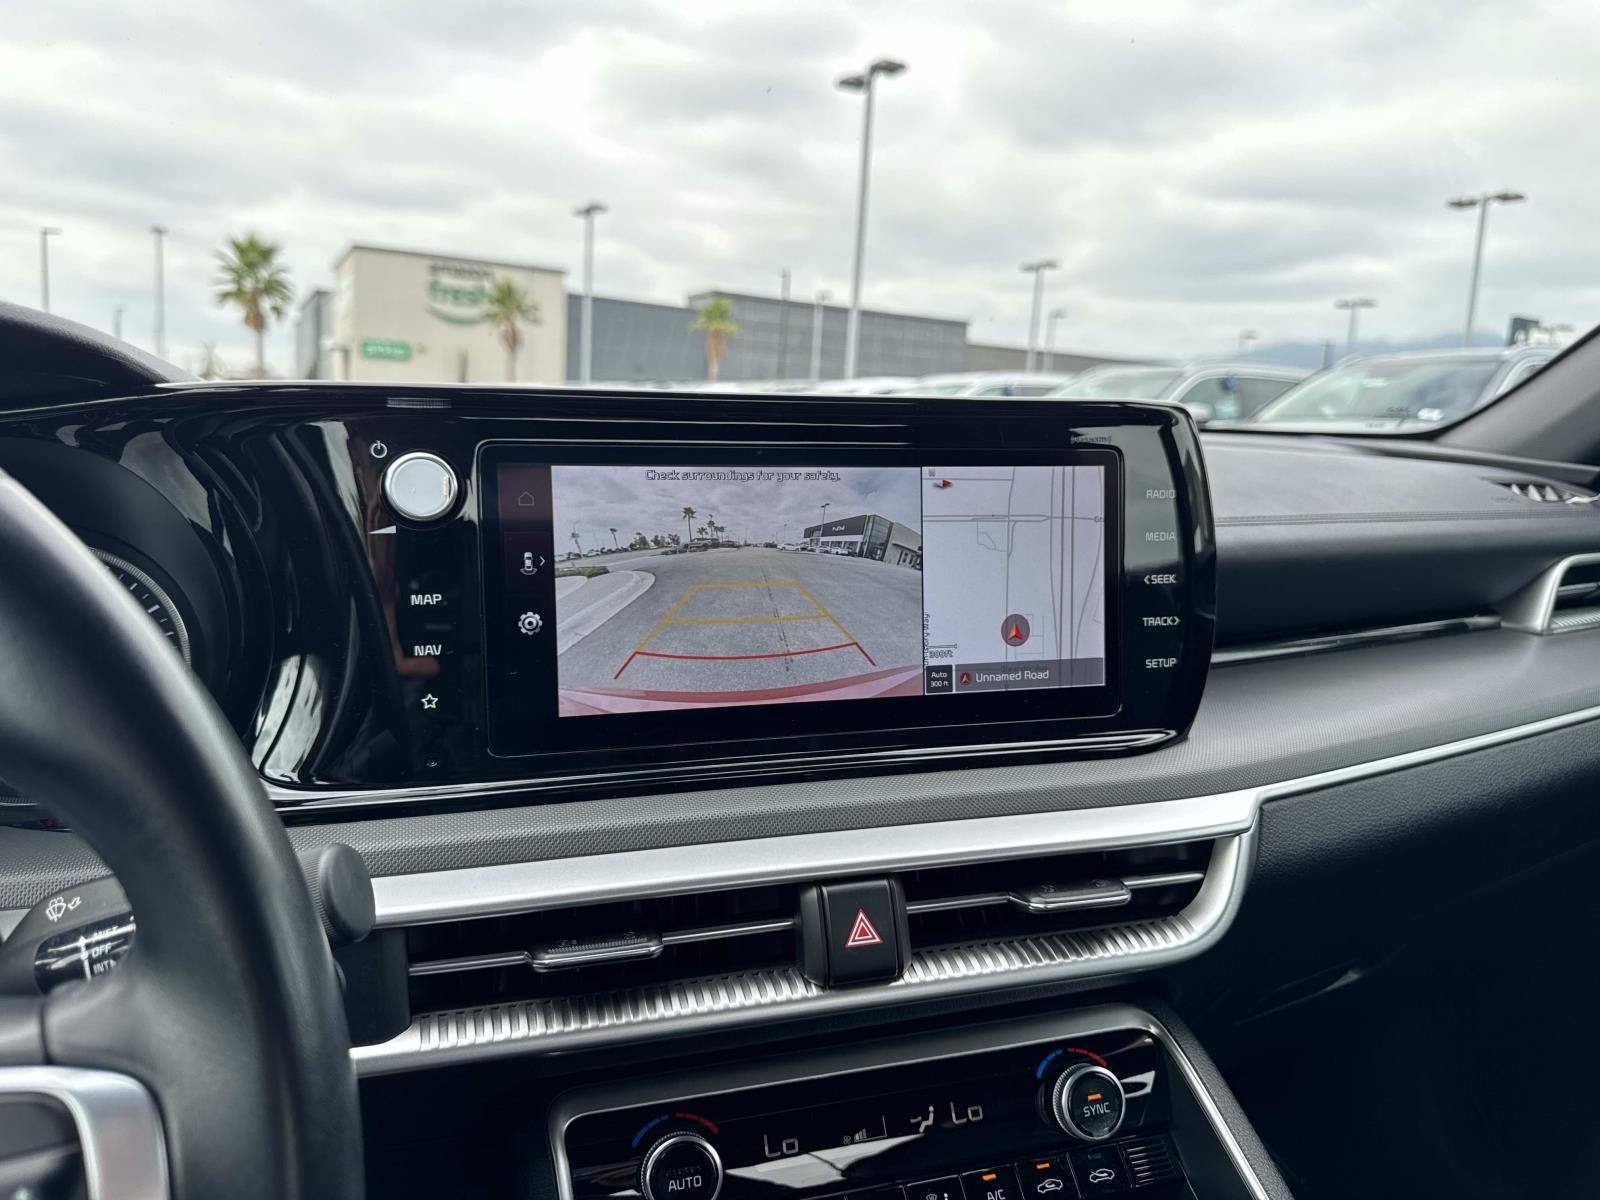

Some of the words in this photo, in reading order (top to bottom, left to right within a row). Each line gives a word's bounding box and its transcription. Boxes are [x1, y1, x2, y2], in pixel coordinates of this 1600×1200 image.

[646, 470, 680, 481] Check
[681, 470, 754, 482] surroundings
[757, 470, 773, 481] for
[777, 472, 801, 482] your
[804, 470, 841, 482] safety.
[1146, 489, 1176, 499] RADIO
[1145, 531, 1176, 542] MEDIA
[410, 593, 442, 606] MAP
[414, 644, 442, 657] NAV
[1145, 658, 1177, 669] SETUP
[975, 671, 1021, 683] Unnamed
[1024, 670, 1050, 680] Road
[91, 942, 111, 959] OFF
[950, 1102, 984, 1124] Lo
[1083, 1102, 1111, 1118] SYNC
[763, 1134, 799, 1158] Lo
[668, 1175, 702, 1193] AUTO
